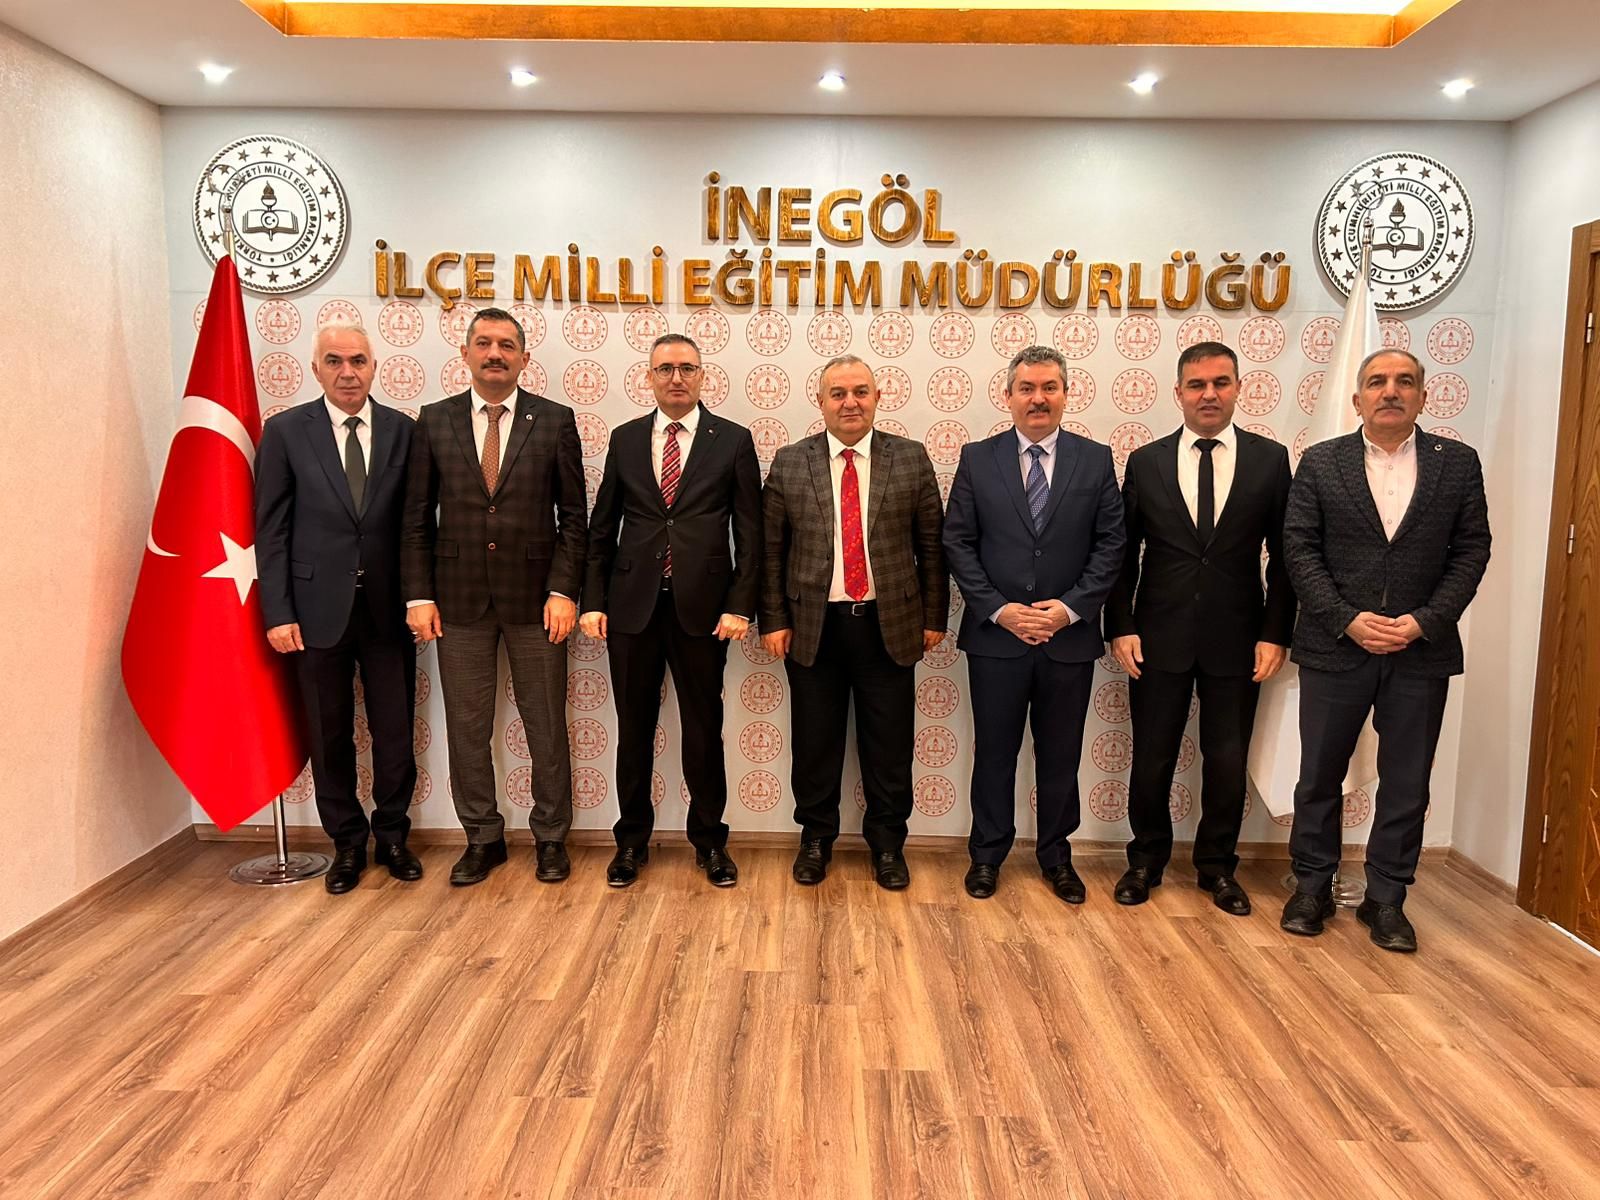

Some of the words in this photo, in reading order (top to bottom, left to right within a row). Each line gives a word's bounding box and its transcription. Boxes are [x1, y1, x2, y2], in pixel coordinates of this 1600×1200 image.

[293, 177, 317, 212] EĞİTİM
[705, 171, 957, 243] İNEGÖL
[1424, 194, 1445, 229] EĞİTİM
[282, 215, 317, 262] BAKANLIĞI
[1404, 233, 1445, 279] BAKANLIĞI
[374, 238, 496, 310] İLÇE
[513, 242, 664, 304] MİLLİ
[683, 247, 881, 307] EĞİTİM
[900, 248, 1292, 311] MÜDÜRLÜĞÜ
